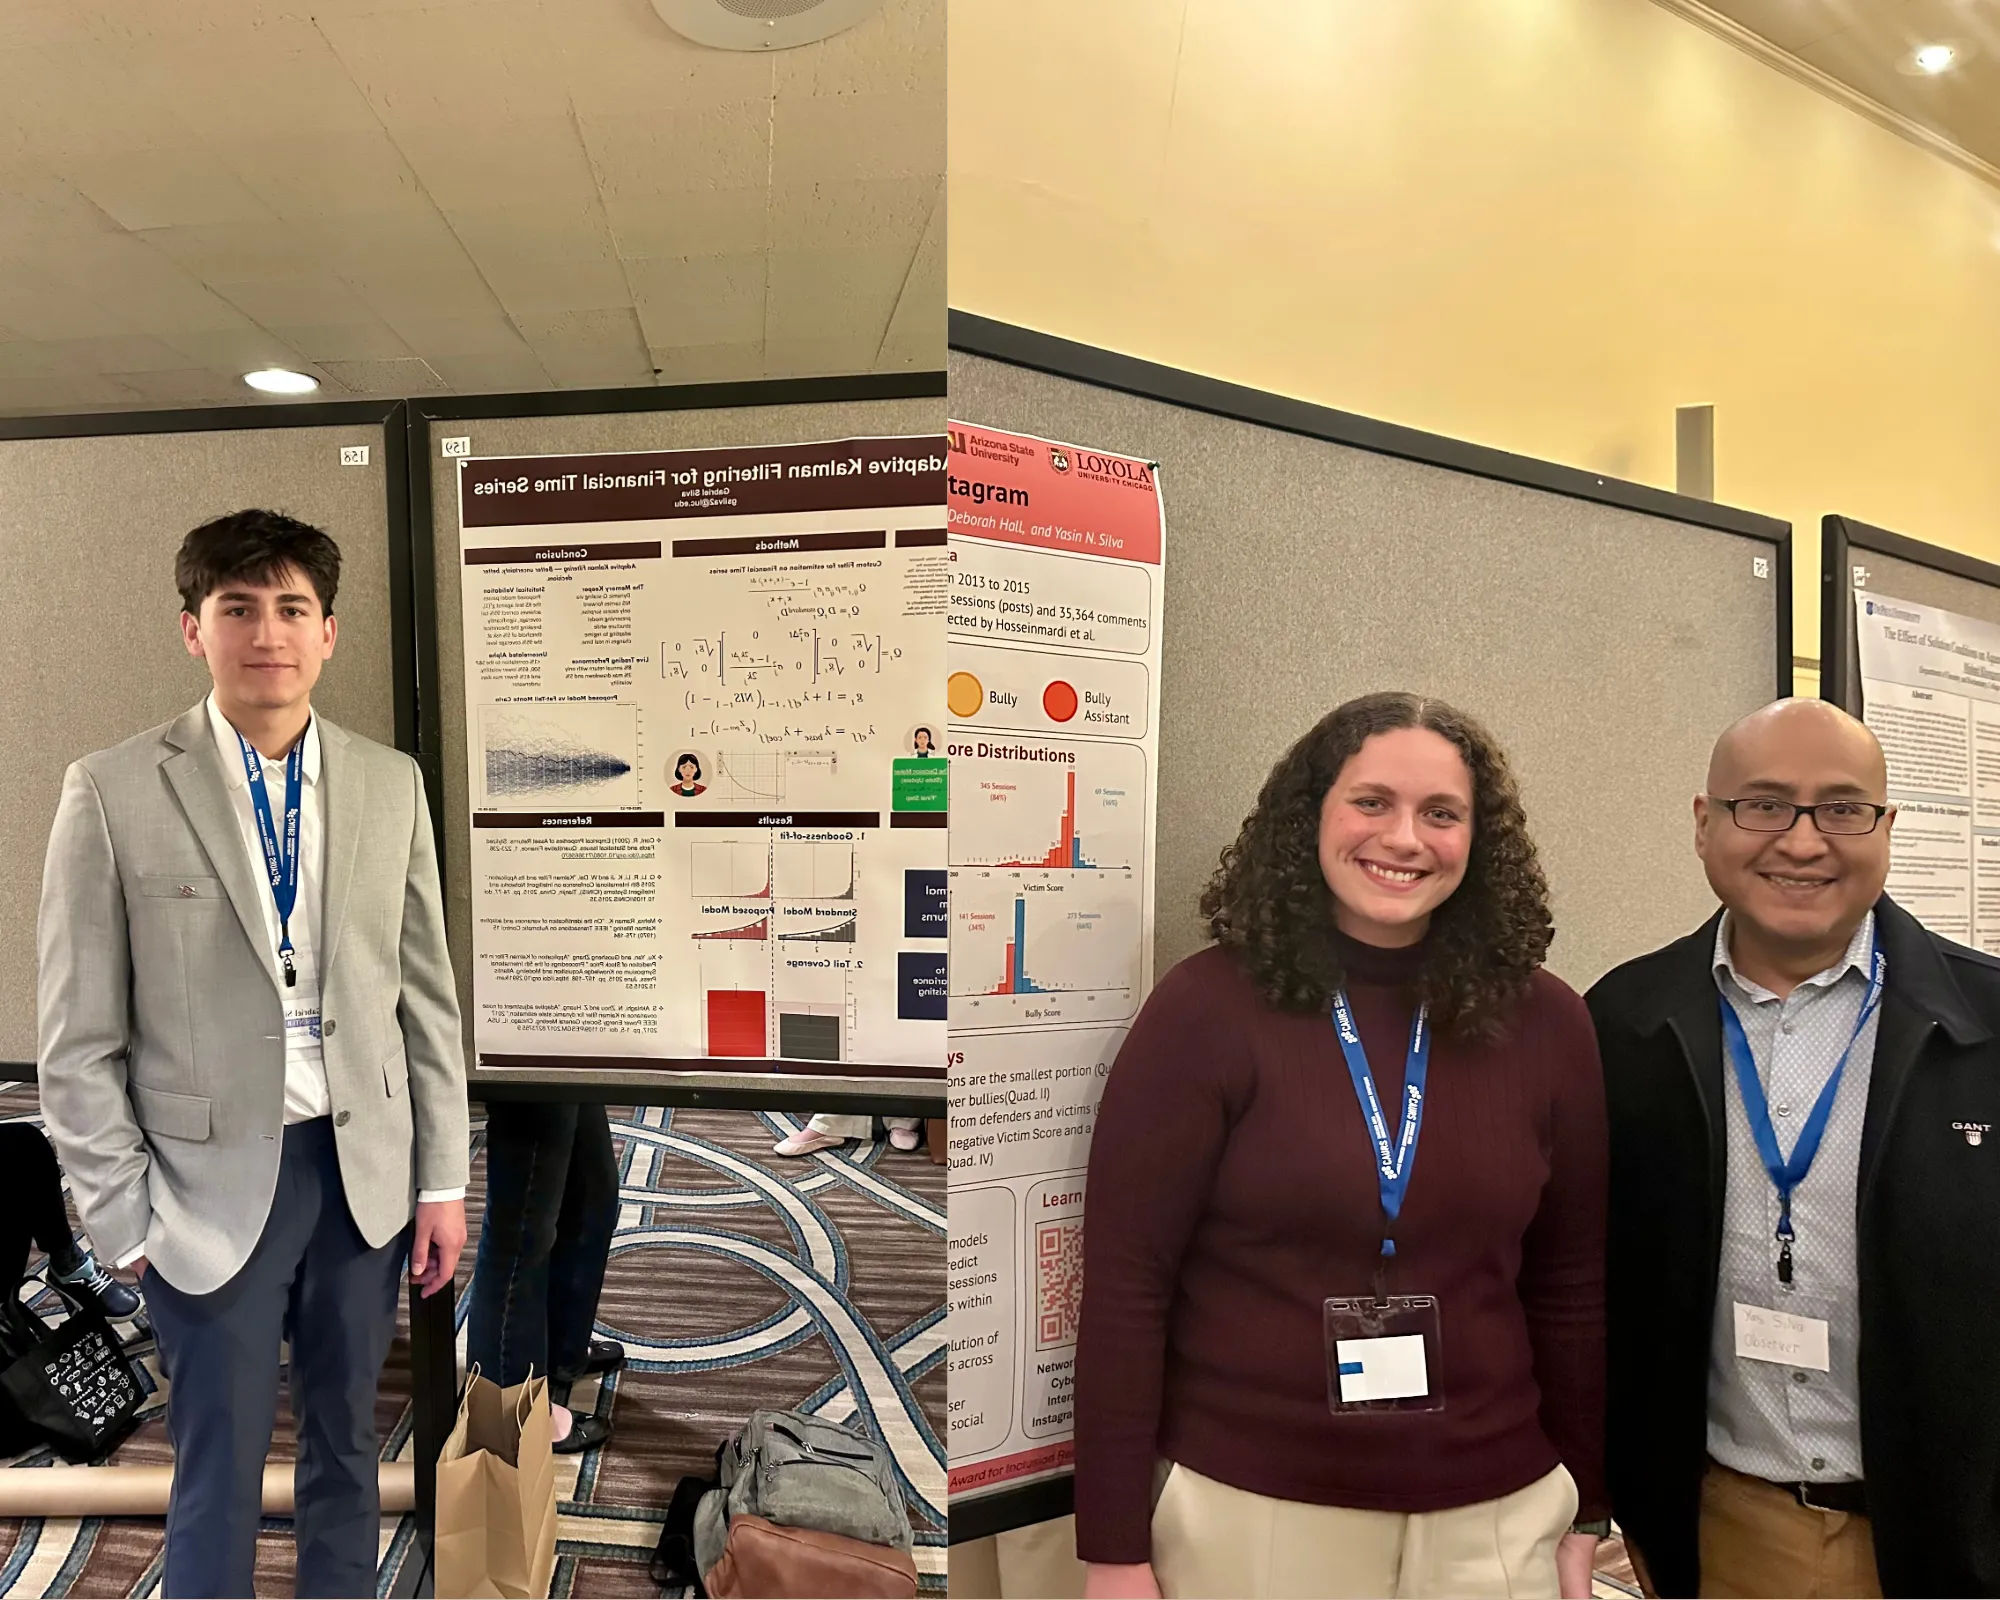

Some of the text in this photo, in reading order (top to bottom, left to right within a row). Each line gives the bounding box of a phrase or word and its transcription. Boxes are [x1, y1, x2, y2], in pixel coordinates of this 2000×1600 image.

[970, 435, 1034, 457] Arizona State
[971, 446, 1019, 466] University
[1076, 453, 1151, 483] LOYOLA
[1078, 471, 1153, 492] UNIVERSITY CHICAGO
[948, 509, 1124, 549] Deborah Hall, and Yasin N. Silva
[958, 572, 1030, 594] 2013 to 2015
[950, 595, 1147, 628] sessions (posts) and 35,364 comments
[981, 615, 994, 632] by
[996, 619, 1067, 639] Hosseinmardi
[1070, 628, 1080, 640] et
[1083, 630, 1096, 642] al.
[989, 691, 1018, 708] Bully
[1085, 692, 1111, 708] Bully
[1084, 710, 1130, 724] Assistant
[978, 743, 1076, 764] Distributions
[992, 783, 1016, 791] Sessions
[1023, 884, 1064, 892] Victim Score
[970, 912, 995, 920] Sessions
[1025, 1008, 1060, 1018] Bully Score
[969, 1075, 986, 1086] are
[990, 1072, 1006, 1084] the
[1010, 1069, 1052, 1082] smallest
[1056, 1066, 1092, 1081] portion
[969, 1089, 1038, 1106] bullies(Quad.
[950, 1104, 1090, 1128] from defenders and victims
[1952, 1122, 1992, 1132] GANT
[950, 1124, 1092, 1151] negative Victim Score and a
[980, 1152, 994, 1166] IV)
[1042, 1192, 1082, 1208] Learn
[949, 1233, 988, 1250] models
[949, 1272, 998, 1290] sessions
[958, 1294, 992, 1310] within
[987, 1330, 1000, 1344] of
[958, 1354, 994, 1370] across
[1037, 1360, 1073, 1374] Networ
[951, 1412, 984, 1431] social
[950, 1468, 986, 1488] Award
[987, 1464, 1004, 1479] for
